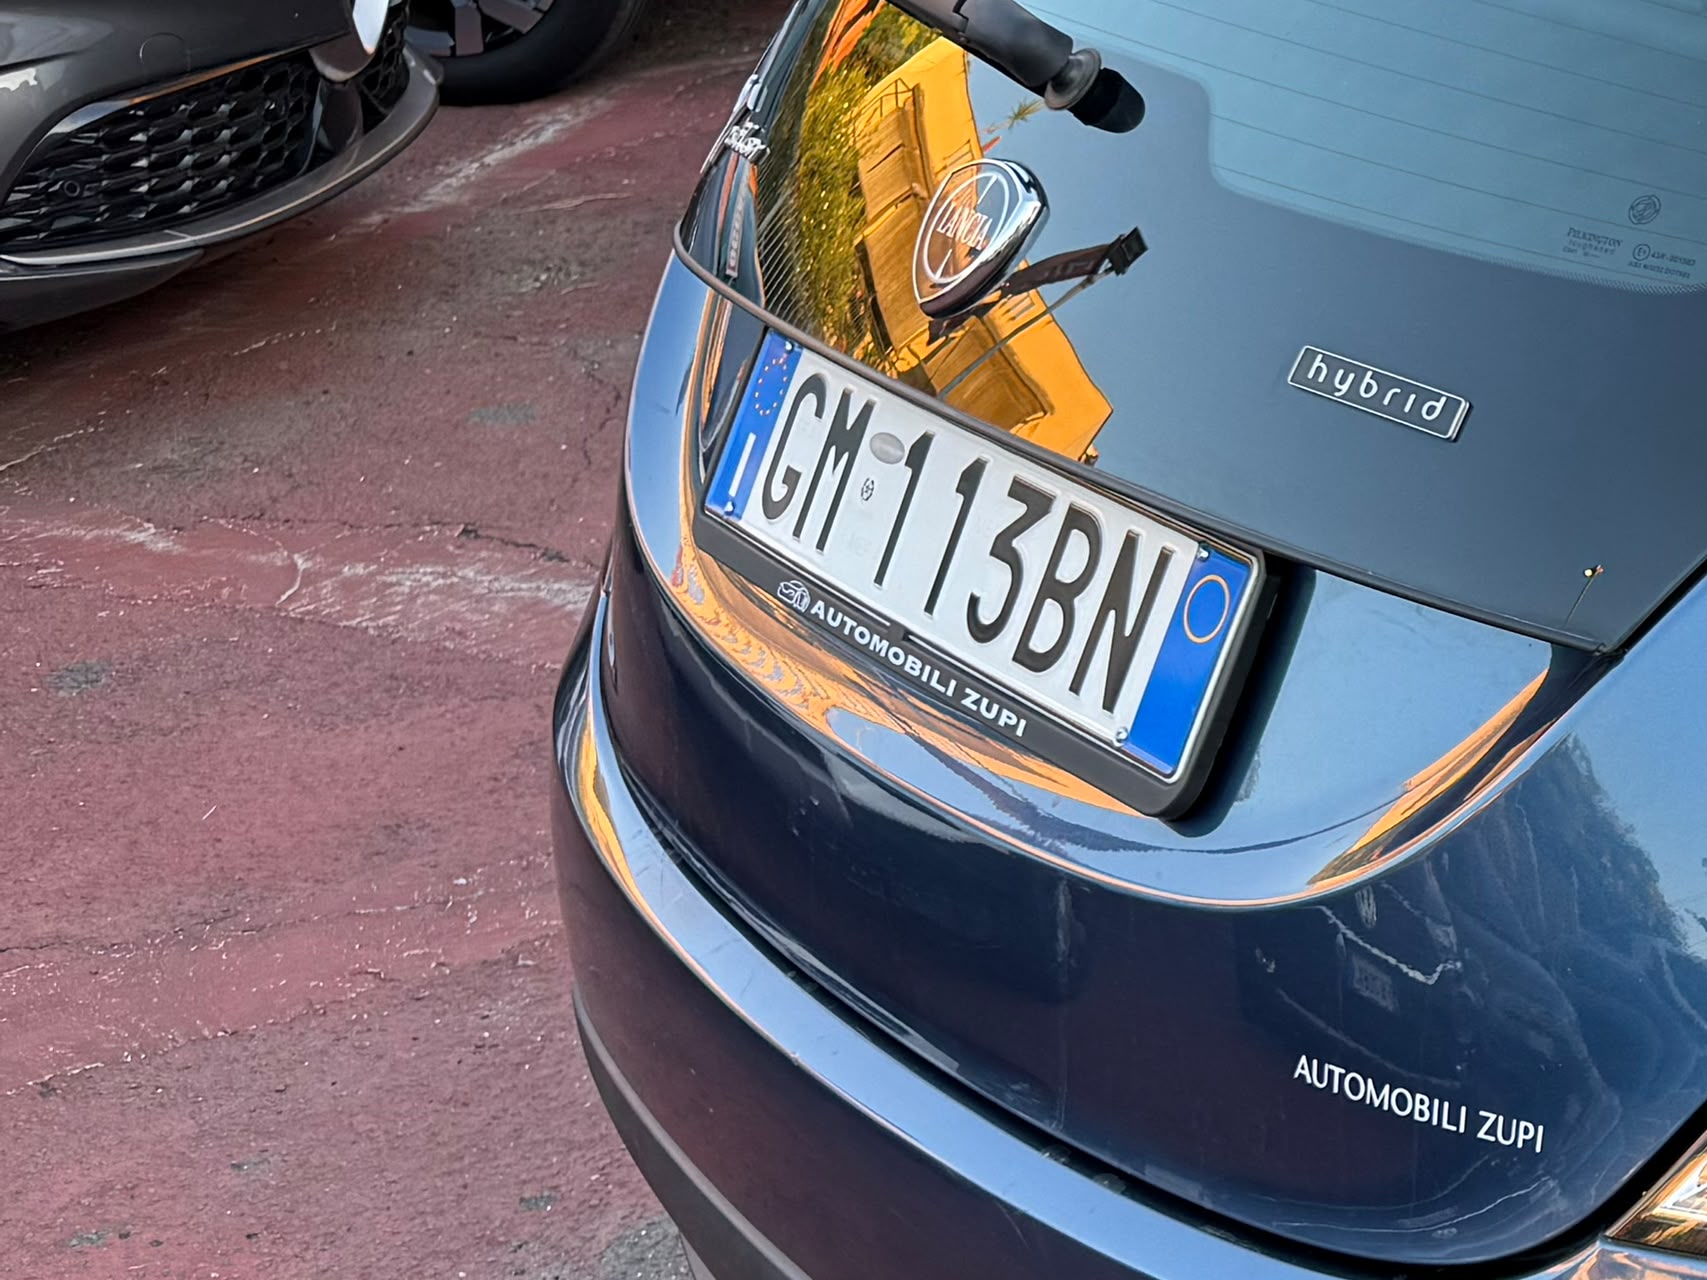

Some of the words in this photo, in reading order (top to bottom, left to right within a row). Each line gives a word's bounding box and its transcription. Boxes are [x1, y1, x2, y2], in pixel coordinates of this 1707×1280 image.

[935, 203, 993, 250] LANCIA
[1305, 352, 1444, 424] hybrid
[811, 600, 959, 698] AUTOMOBILI
[961, 685, 1028, 738] ZUPI
[1294, 1054, 1467, 1133] AUTOMOBILI
[1477, 1111, 1545, 1153] ZUPI
